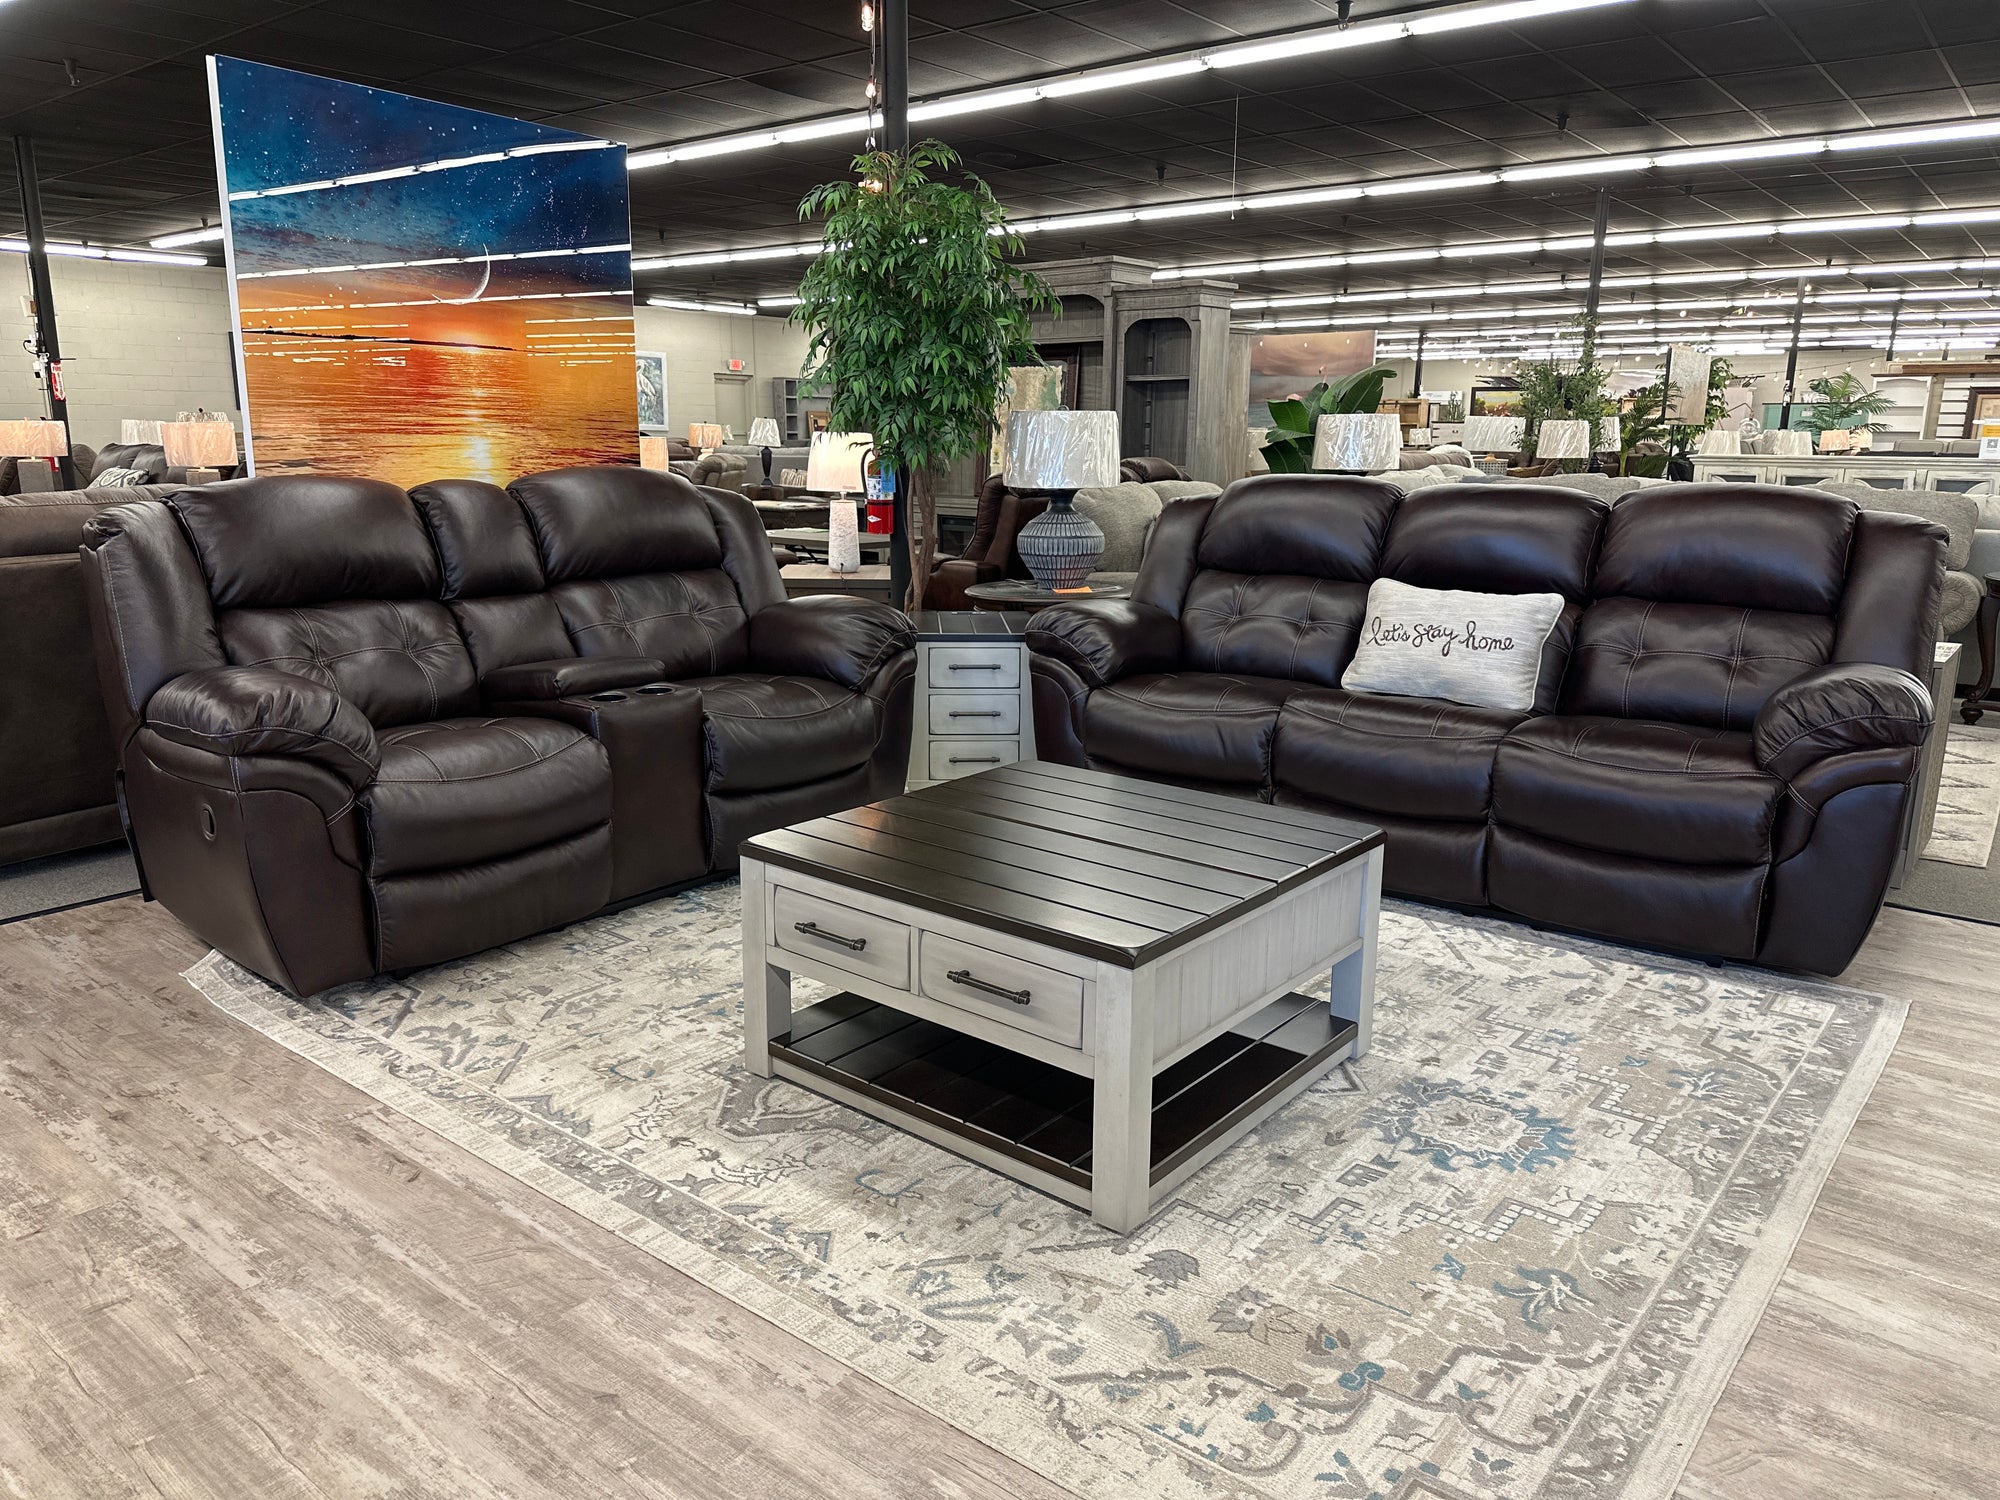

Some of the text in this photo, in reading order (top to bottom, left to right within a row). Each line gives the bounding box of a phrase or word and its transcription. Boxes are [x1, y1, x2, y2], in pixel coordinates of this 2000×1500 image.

[1366, 616, 1514, 657] let's stay home
